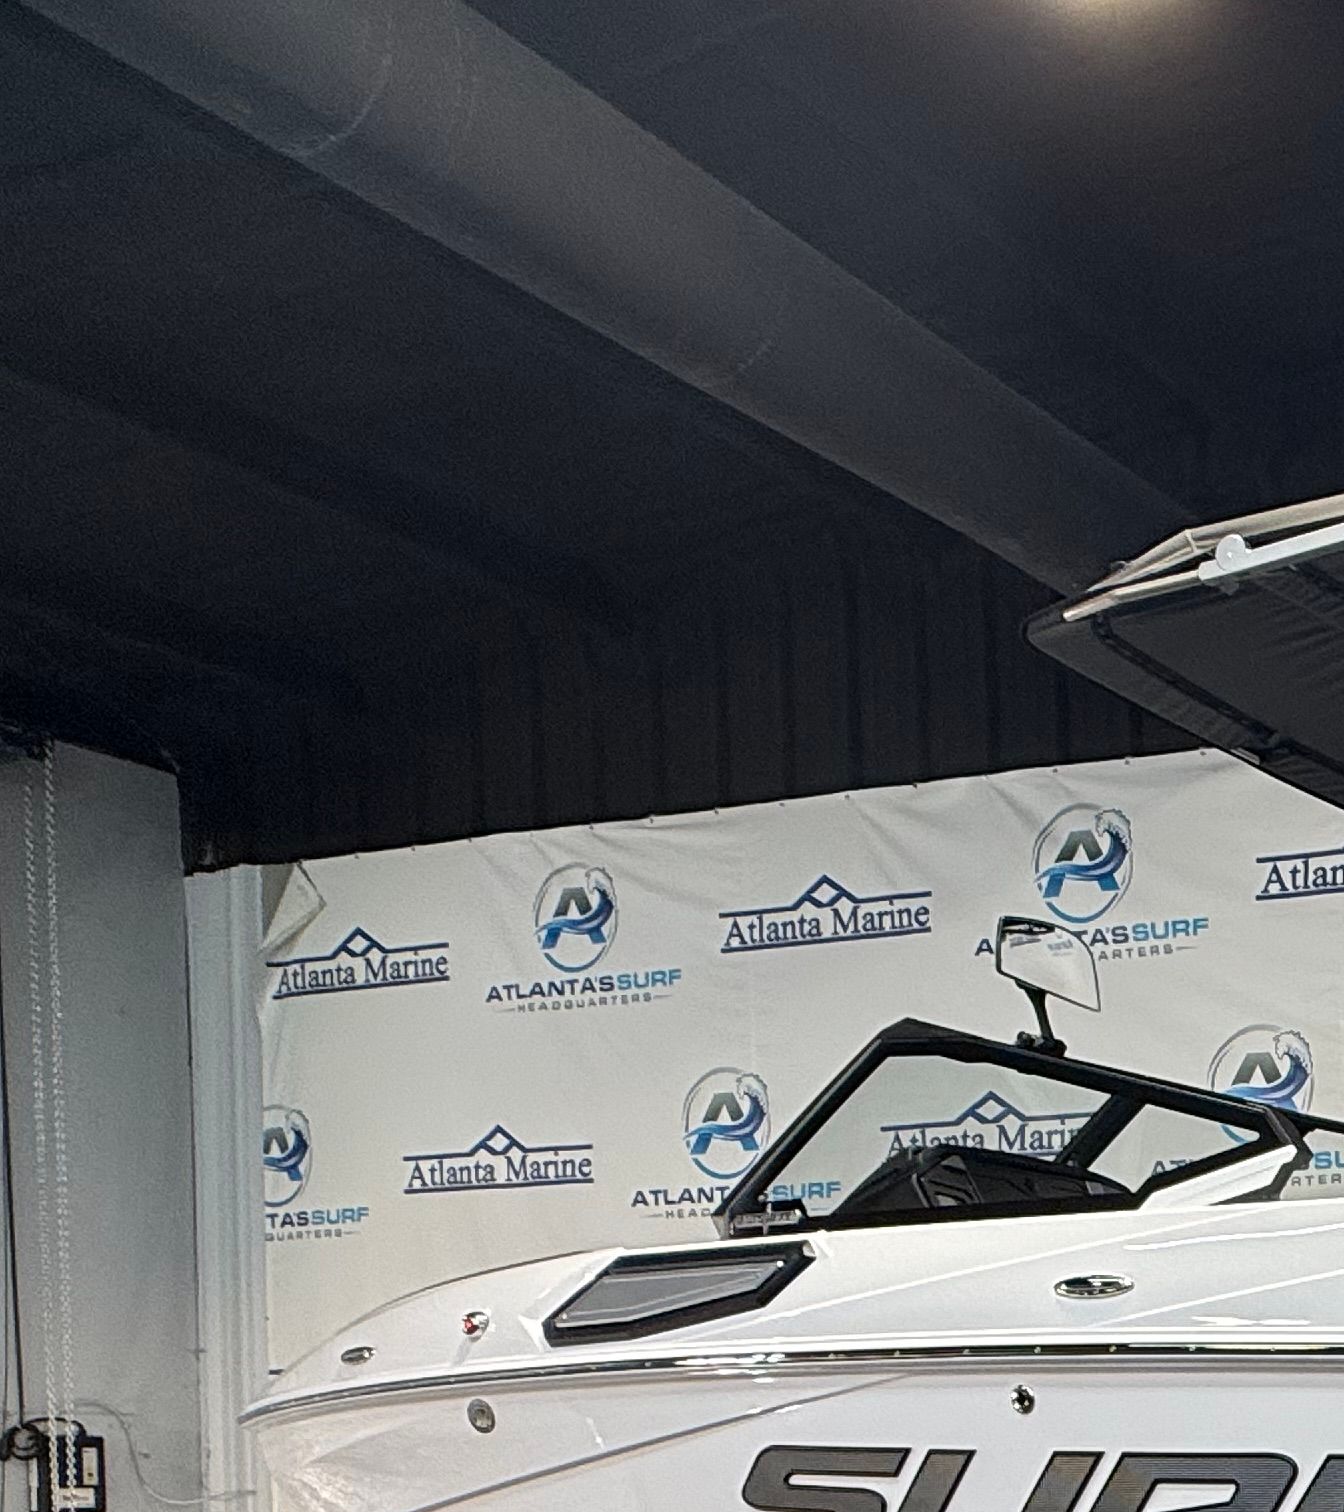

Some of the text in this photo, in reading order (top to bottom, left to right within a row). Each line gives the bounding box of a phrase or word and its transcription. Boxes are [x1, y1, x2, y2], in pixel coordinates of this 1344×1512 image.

[724, 899, 930, 947] Atlanta Marine
[277, 951, 448, 993] Atlanta Marine
[517, 991, 653, 1013] HEADQUARTERS
[408, 1150, 593, 1188] Atlanta Marine
